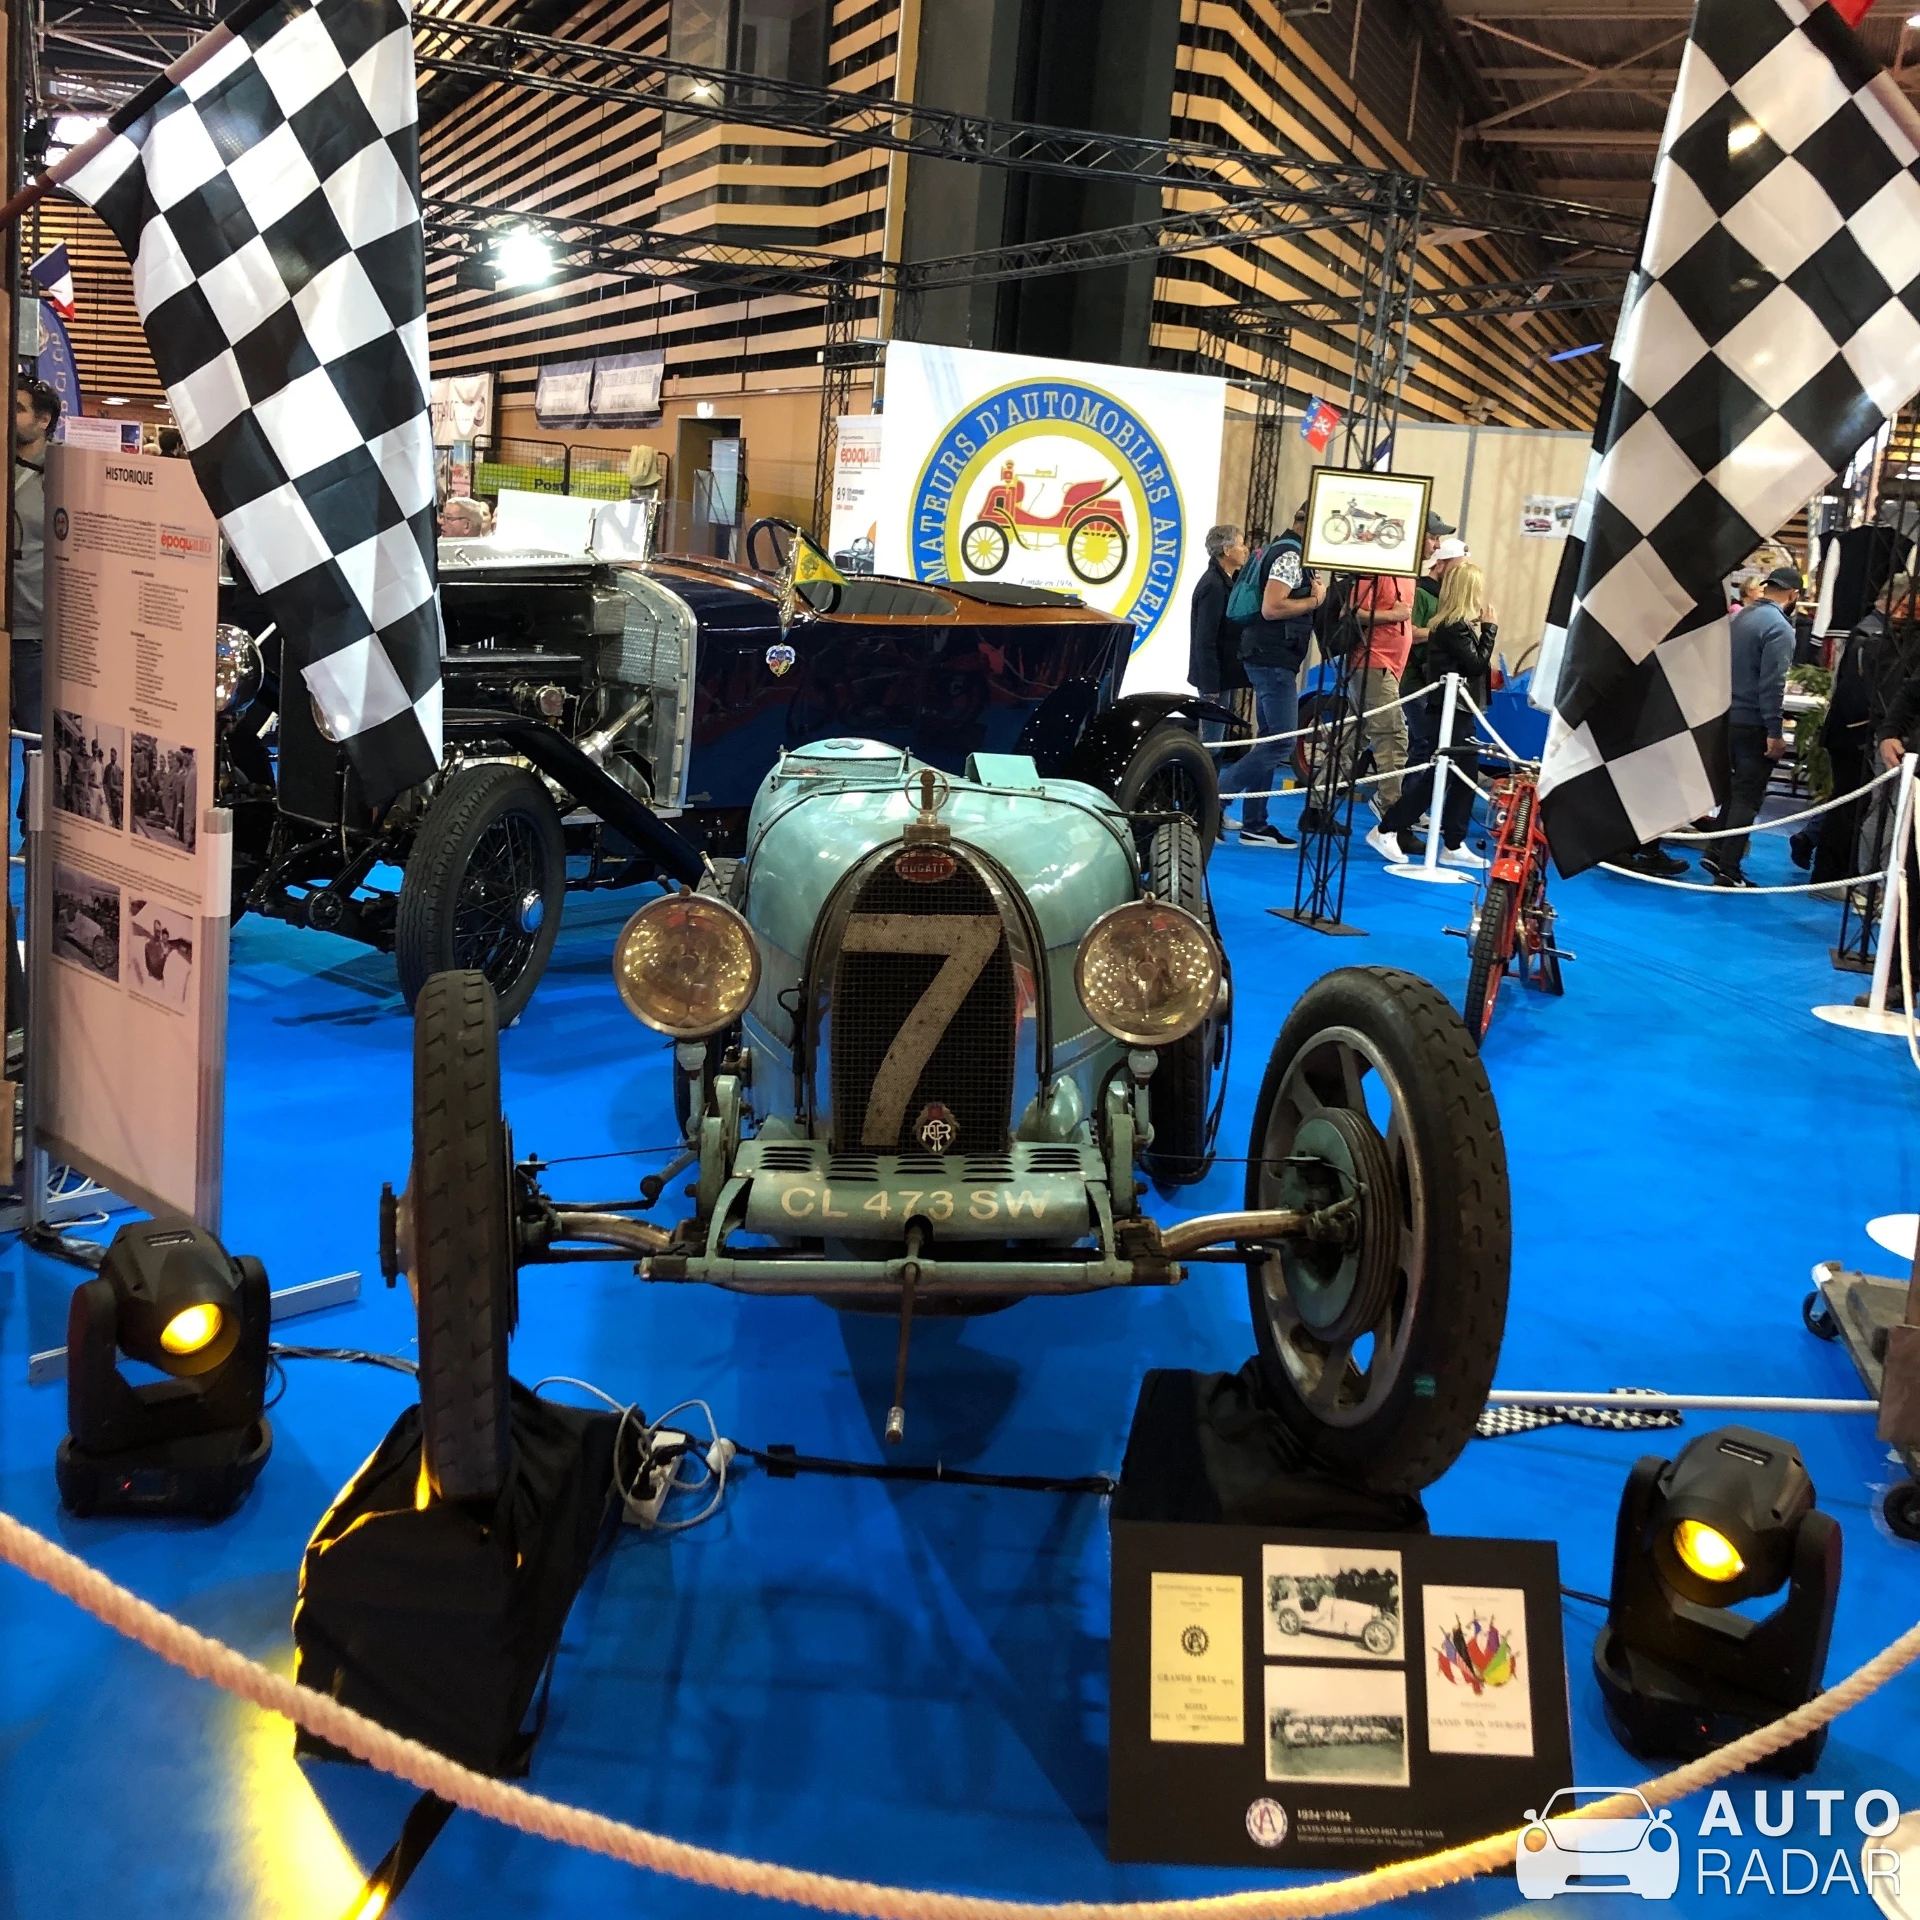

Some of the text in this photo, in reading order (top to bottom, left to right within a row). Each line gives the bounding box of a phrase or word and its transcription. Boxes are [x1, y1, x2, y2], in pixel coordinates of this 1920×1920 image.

[105, 466, 154, 485] HISTORIQUE
[534, 478, 575, 493] Pose
[919, 391, 1177, 641] MATEURS D'AUTOMOBILES ANCIEN
[901, 863, 946, 874] BUGATT
[841, 913, 1002, 1146] 7
[781, 1187, 1050, 1220] CL 473 SW
